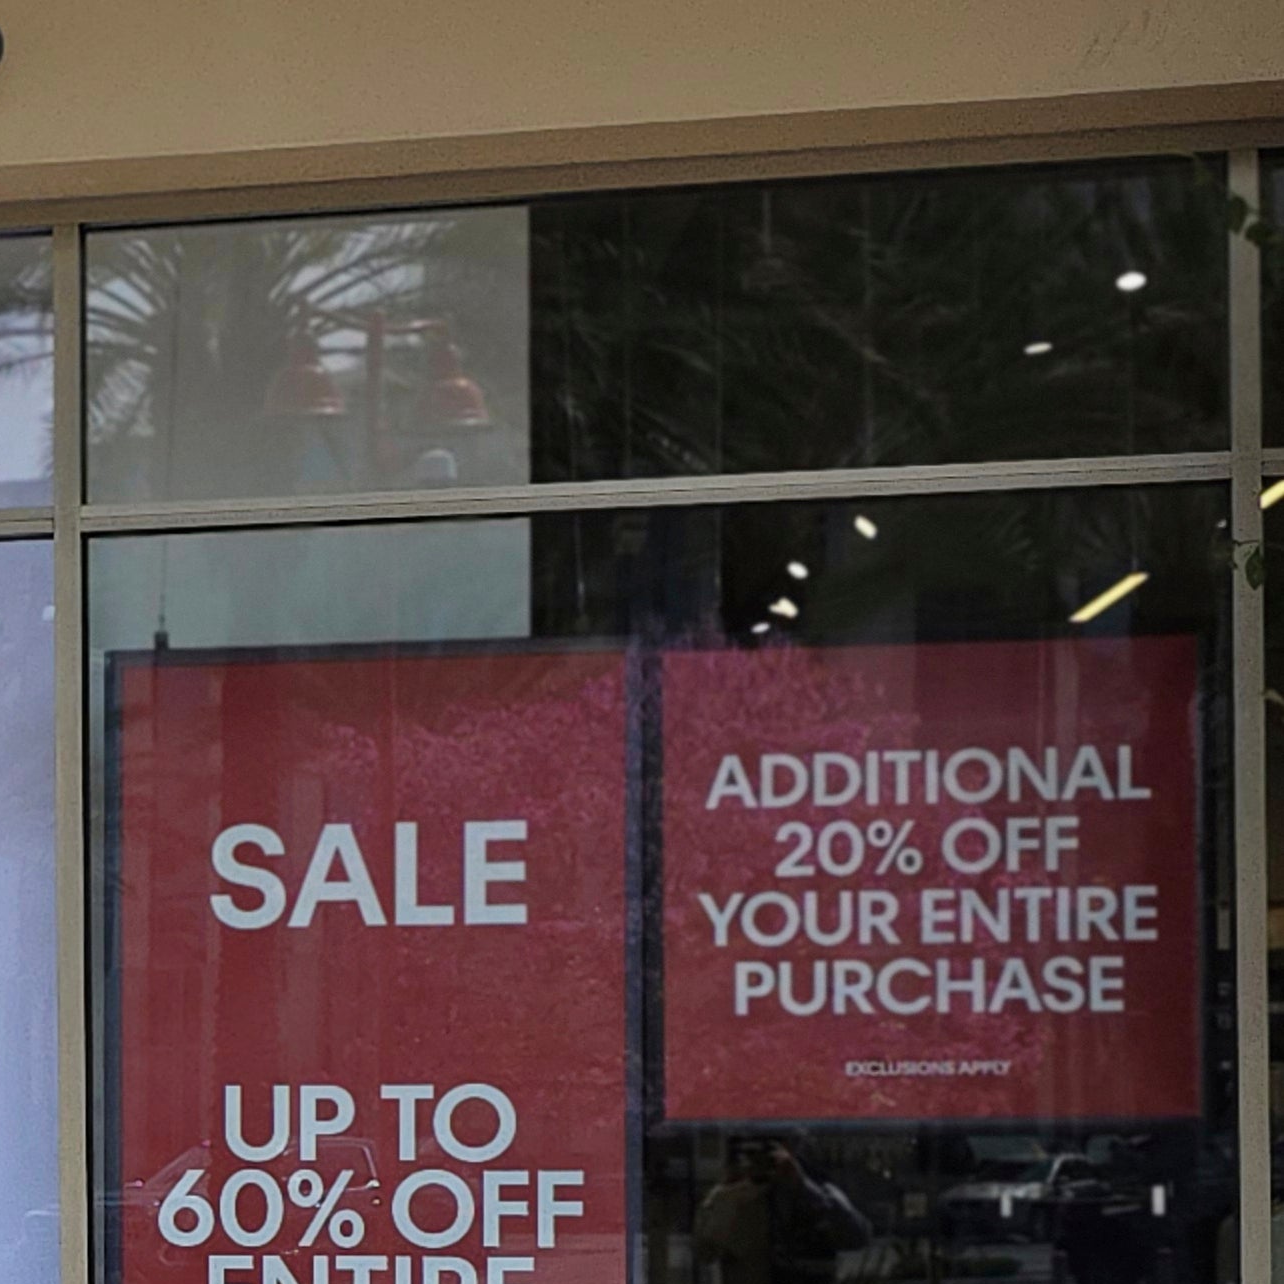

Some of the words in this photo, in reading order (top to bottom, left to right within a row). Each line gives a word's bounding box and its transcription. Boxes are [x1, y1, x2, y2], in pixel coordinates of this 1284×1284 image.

[707, 746, 1151, 810] ADDITIONAL
[211, 820, 529, 931] SALE
[776, 820, 923, 877] 20%
[943, 817, 1080, 874] OFF
[699, 891, 900, 947] YOUR
[922, 886, 1158, 944] ENTIRE
[736, 957, 1125, 1017] PURCHASE
[845, 1060, 955, 1077] EXCLUSIONS
[958, 1060, 1012, 1076] APPLY
[225, 1085, 357, 1164] UP
[381, 1084, 518, 1165] TO
[158, 1169, 367, 1250] 60%
[391, 1169, 586, 1250] OFF
